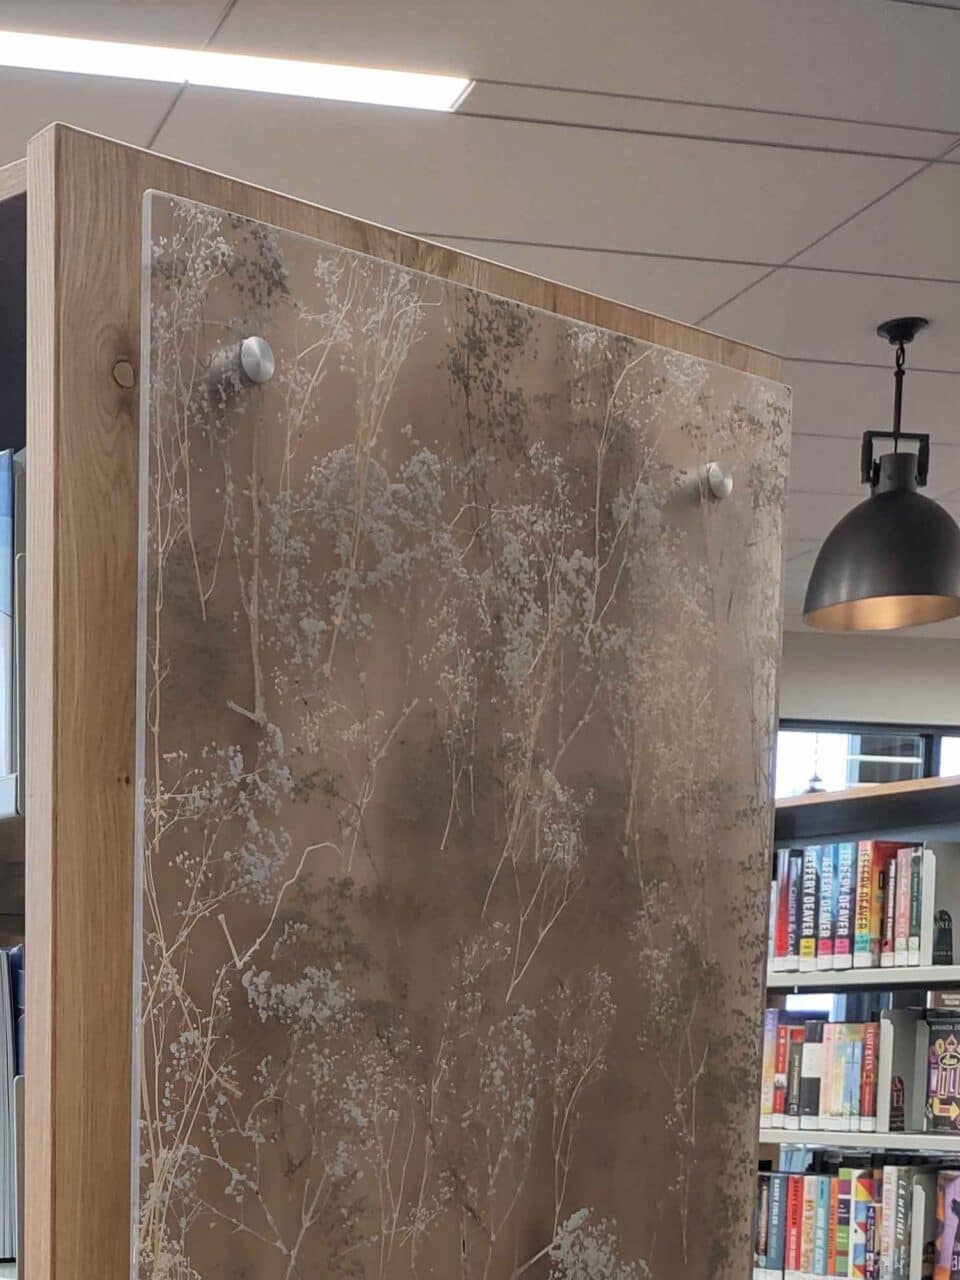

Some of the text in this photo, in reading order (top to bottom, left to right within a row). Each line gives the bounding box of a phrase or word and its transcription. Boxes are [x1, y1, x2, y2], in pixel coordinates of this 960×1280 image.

[802, 851, 816, 936] JEFFERY DEAVER
[820, 857, 833, 938] JEFFERY DEAVER
[837, 896, 850, 936] DEAVER
[857, 892, 868, 930] DEAVER
